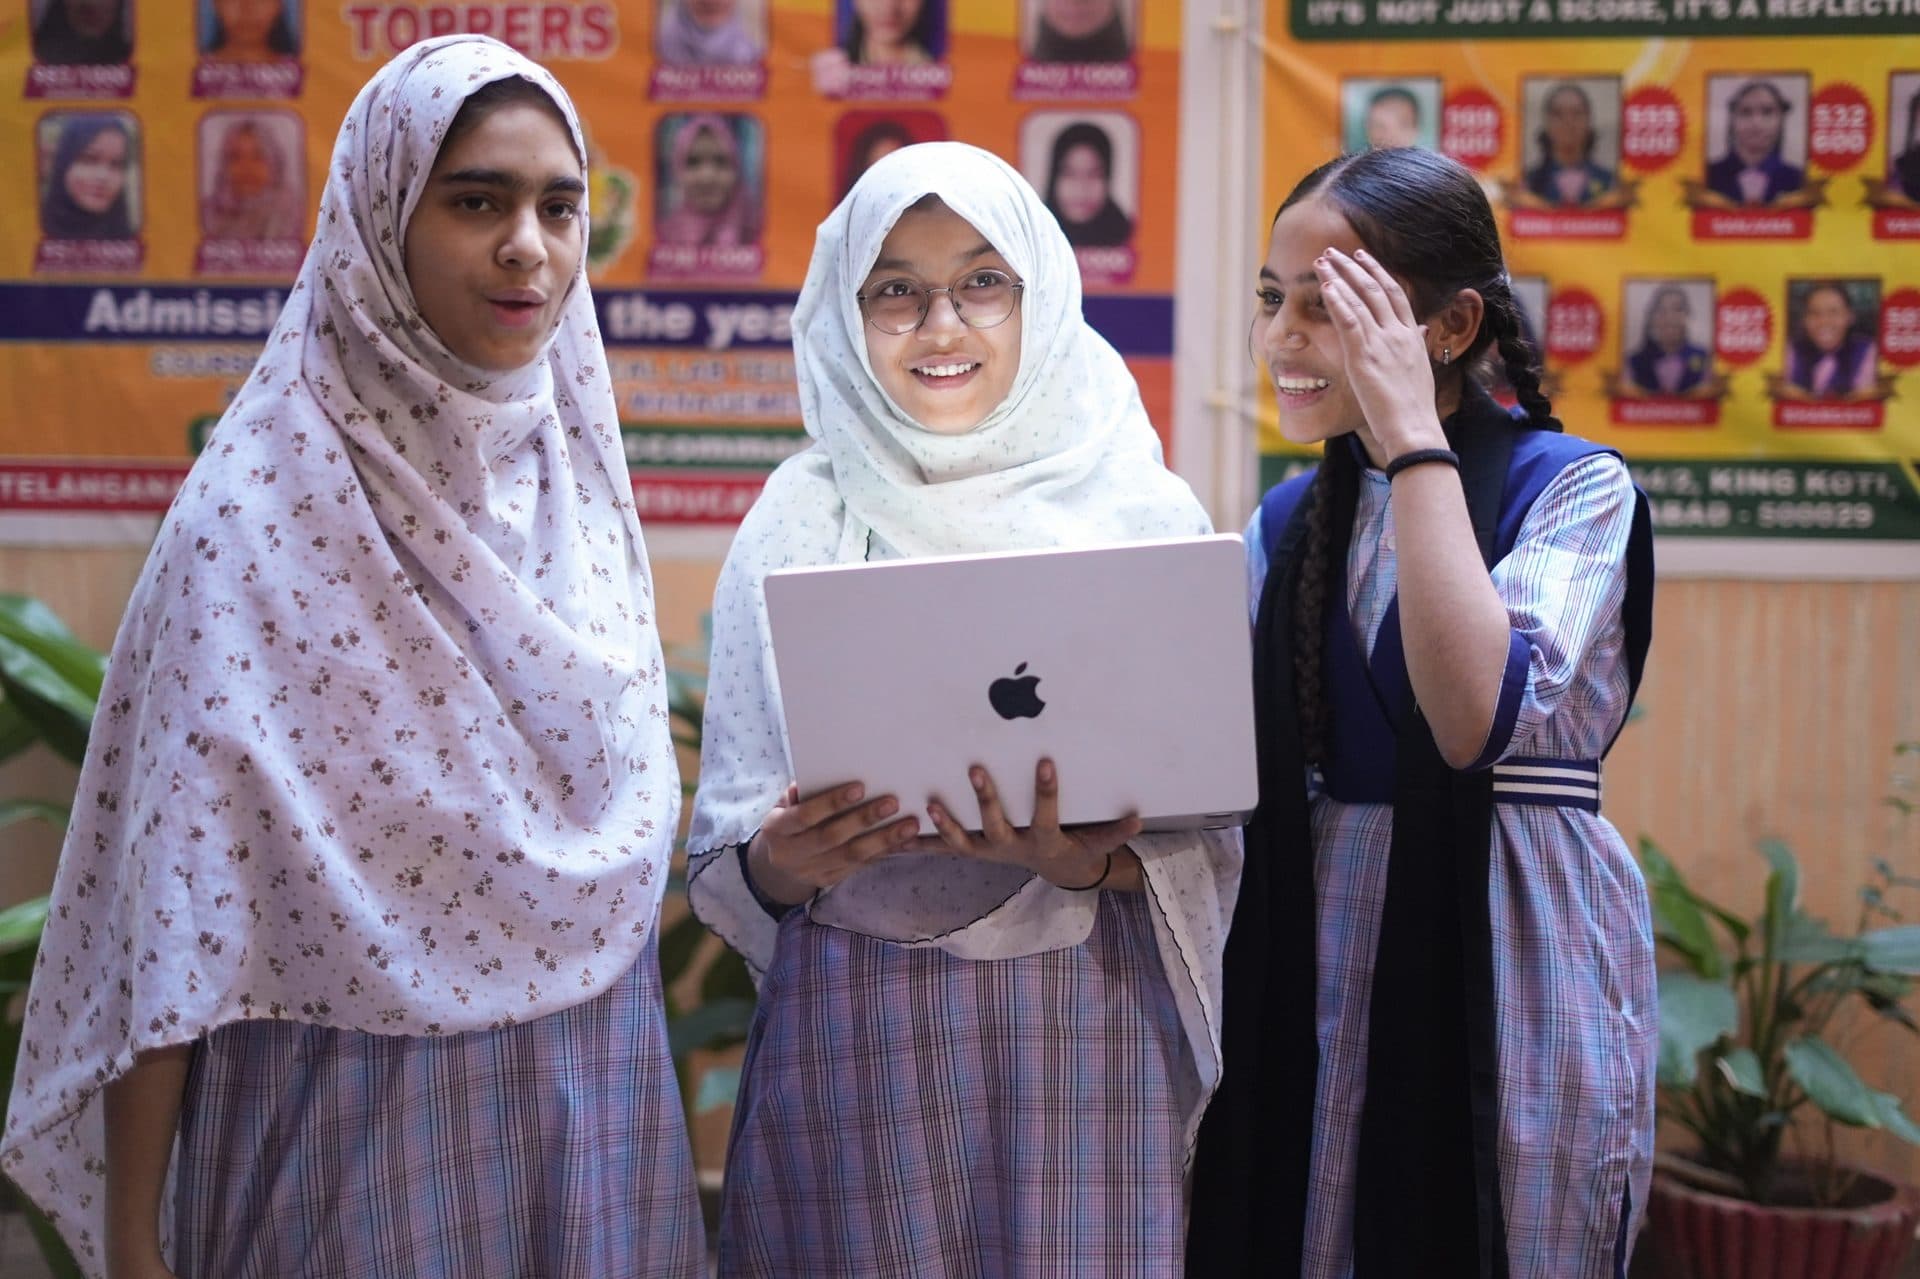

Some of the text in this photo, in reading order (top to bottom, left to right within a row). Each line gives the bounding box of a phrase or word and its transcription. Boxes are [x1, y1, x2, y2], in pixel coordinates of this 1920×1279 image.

[348, 4, 611, 55] TOPPERS
[1813, 104, 1867, 128] 532
[1624, 131, 1680, 155] 600
[1811, 130, 1866, 154] 600
[85, 287, 284, 334] Admissi
[606, 295, 696, 339] the
[1718, 330, 1767, 352] 600
[1885, 332, 1920, 353] 60
[1708, 468, 1797, 496] KING
[1805, 469, 1897, 500] KOTI,
[1756, 502, 1875, 529] 500029
